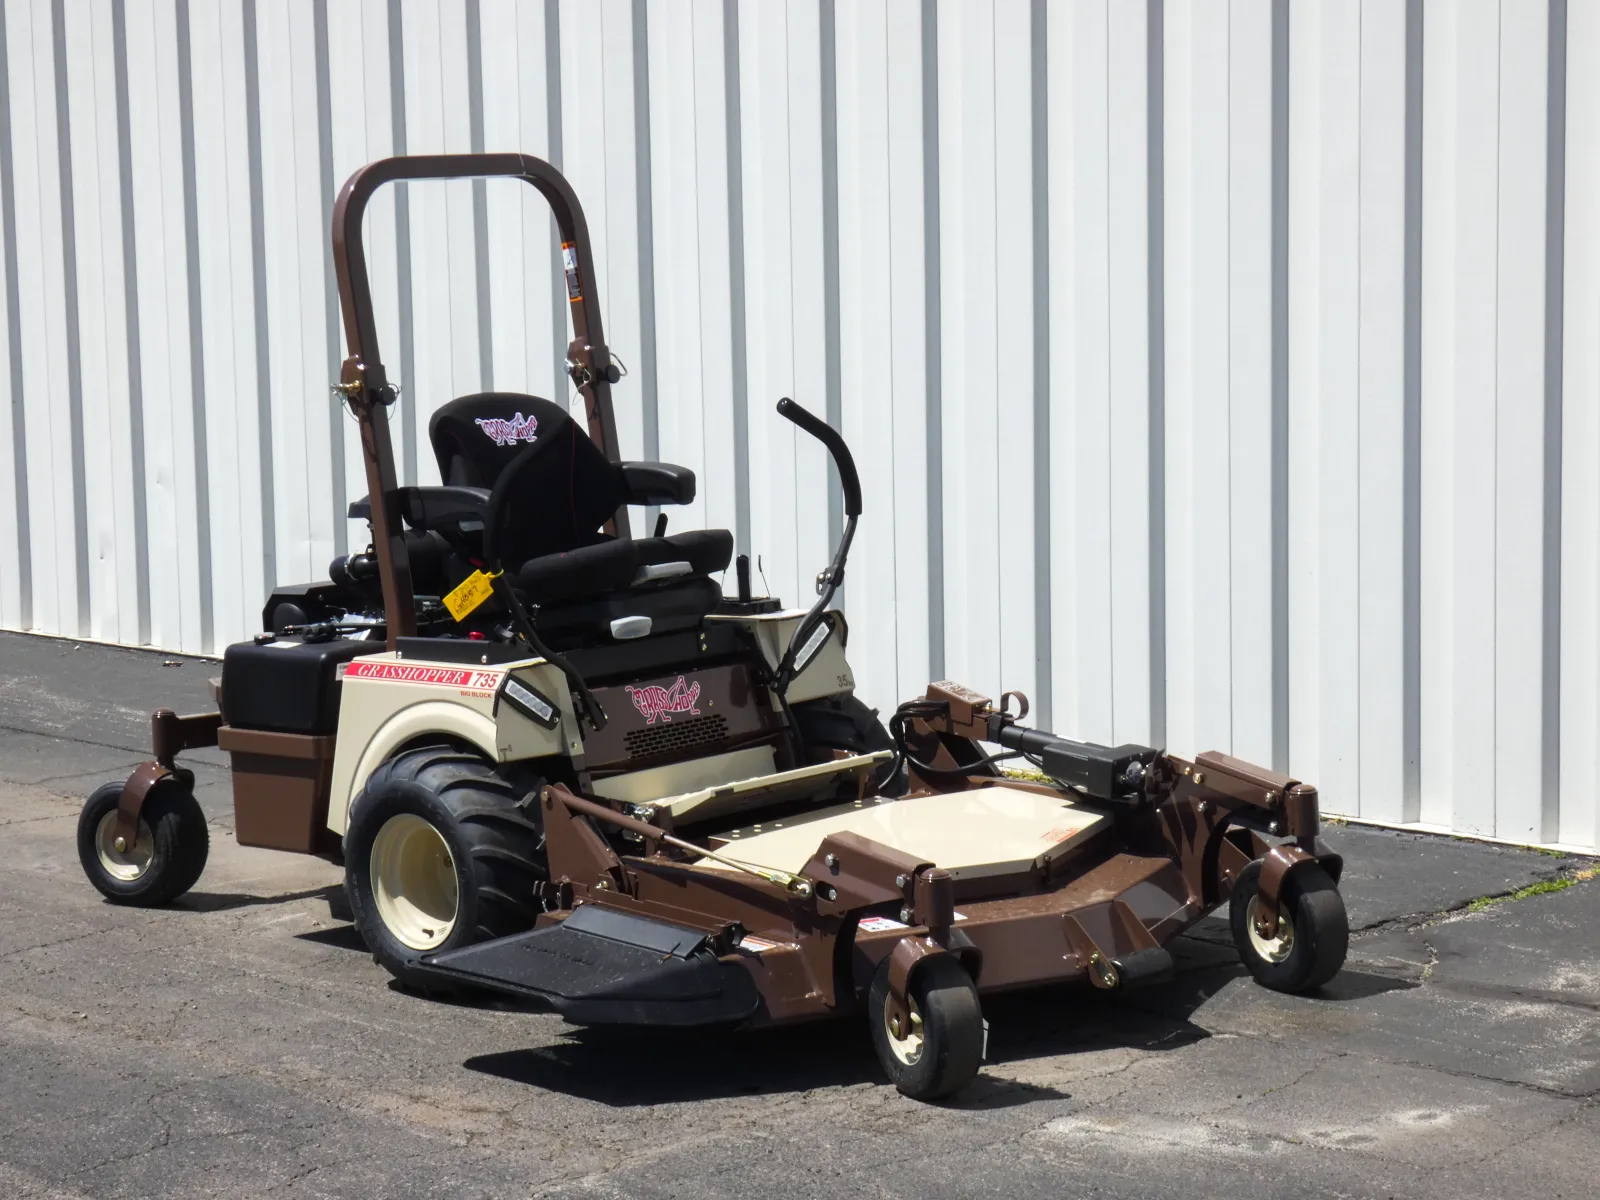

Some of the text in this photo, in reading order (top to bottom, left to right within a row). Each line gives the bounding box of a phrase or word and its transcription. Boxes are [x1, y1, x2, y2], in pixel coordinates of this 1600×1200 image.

[358, 663, 465, 684] GRASSHOPPER
[473, 672, 498, 687] 735
[625, 675, 701, 725] GRASSHOPPER
